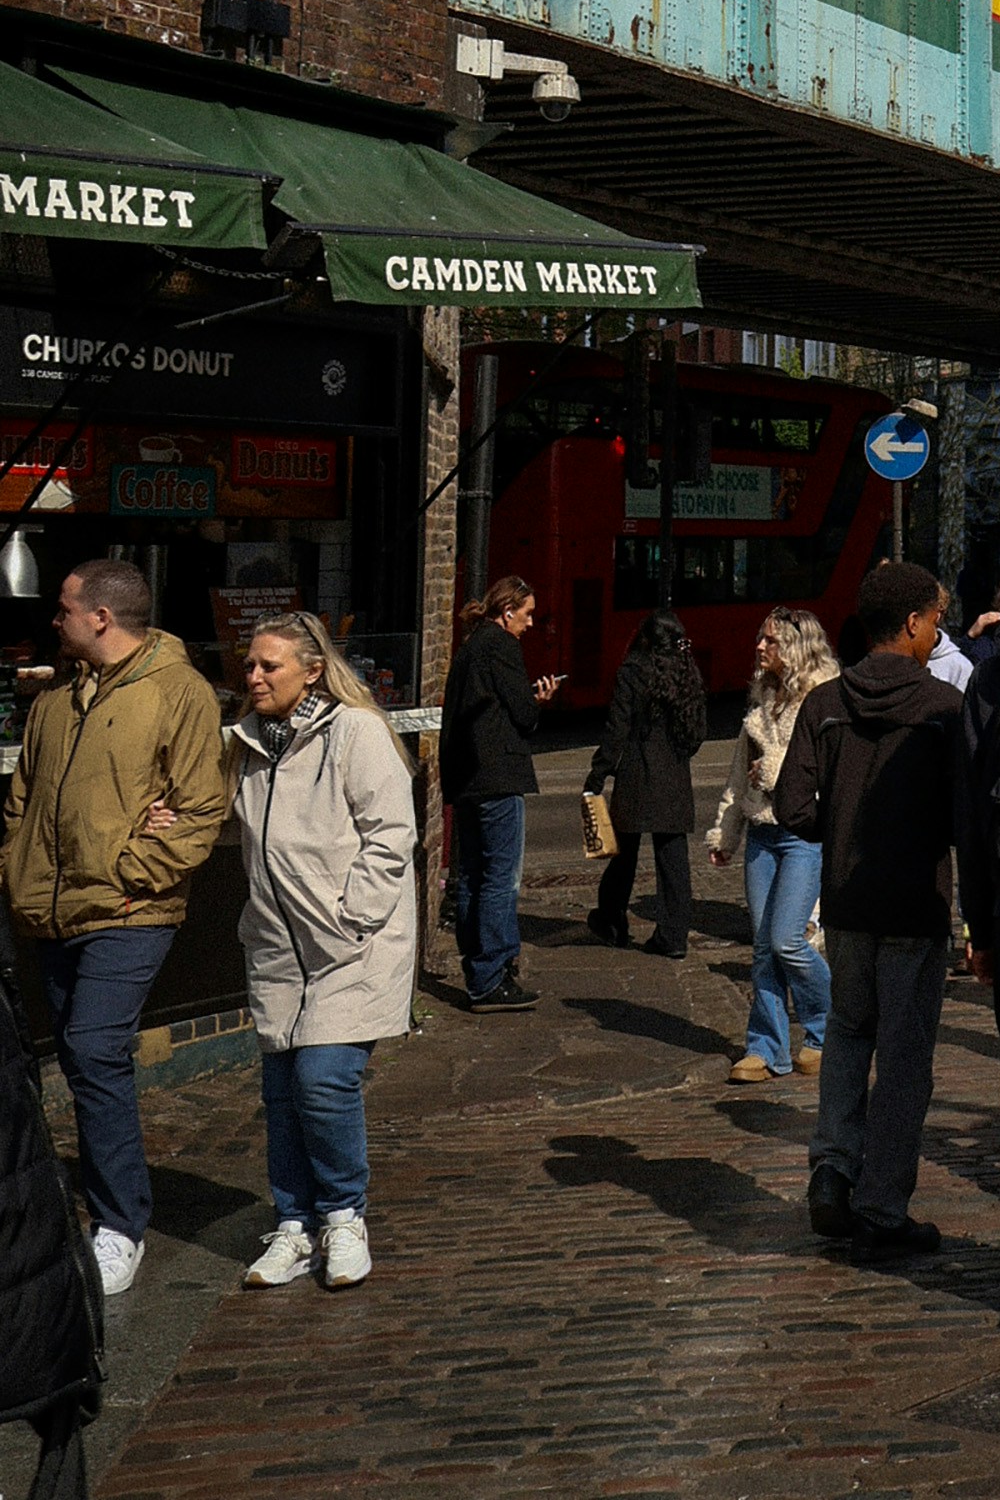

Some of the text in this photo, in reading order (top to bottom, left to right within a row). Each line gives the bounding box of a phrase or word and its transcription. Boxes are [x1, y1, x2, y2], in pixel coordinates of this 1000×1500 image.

[0, 173, 196, 229] MARKET
[385, 255, 658, 296] CAMDEN MARKET
[36, 369, 69, 380] CAMDEN
[152, 345, 235, 378] DONUT
[0, 434, 88, 470] urros
[236, 438, 331, 484] Donuts
[118, 467, 210, 510] Coffee
[717, 470, 759, 492] CHOOSE
